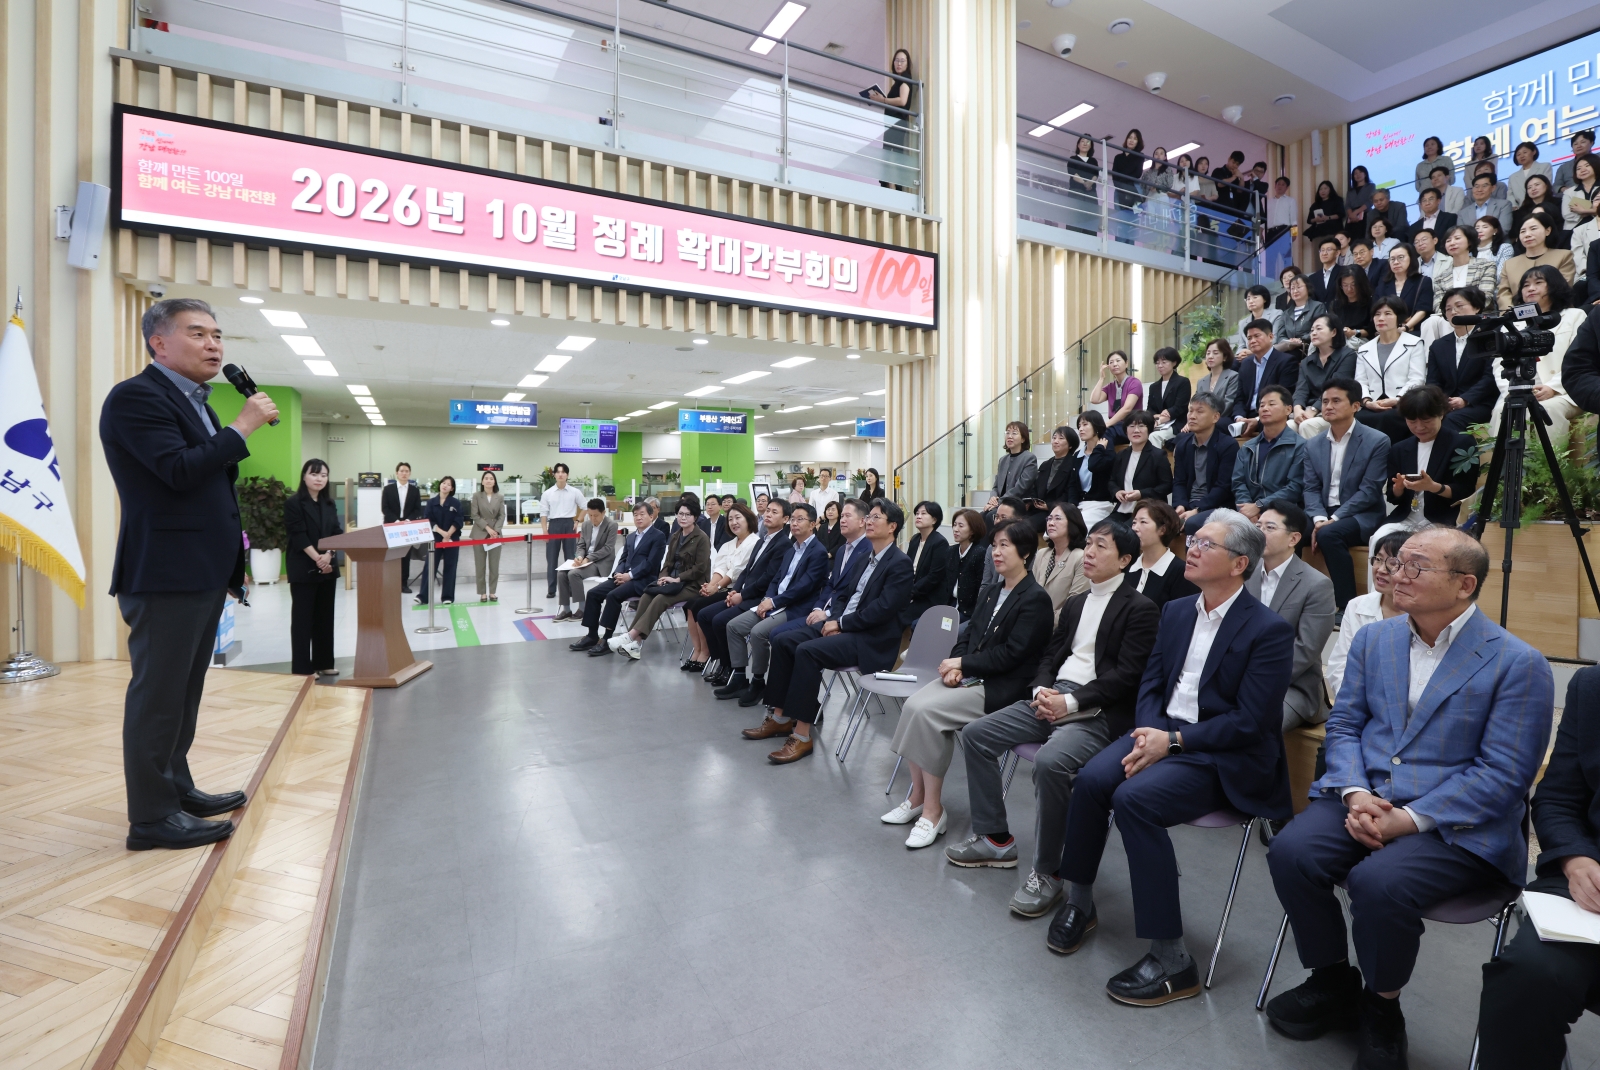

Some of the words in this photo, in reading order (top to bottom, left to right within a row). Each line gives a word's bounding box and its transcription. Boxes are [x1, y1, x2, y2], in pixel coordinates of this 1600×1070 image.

[1482, 70, 1554, 124] 함께
[137, 158, 169, 177] 함께
[171, 164, 201, 181] 만든
[204, 169, 244, 187] 100일
[137, 173, 169, 191] 함께
[171, 178, 201, 196] 여는
[203, 183, 233, 200] 강남
[234, 188, 277, 206] 대전환
[291, 166, 466, 237] 2026년
[485, 198, 577, 252] 10월
[592, 213, 664, 265] 정례
[677, 227, 859, 294] 확대간부회의
[456, 403, 462, 411] 1
[475, 404, 500, 415] 부동산
[699, 414, 718, 424] 부동산
[719, 415, 743, 425] 거래신고
